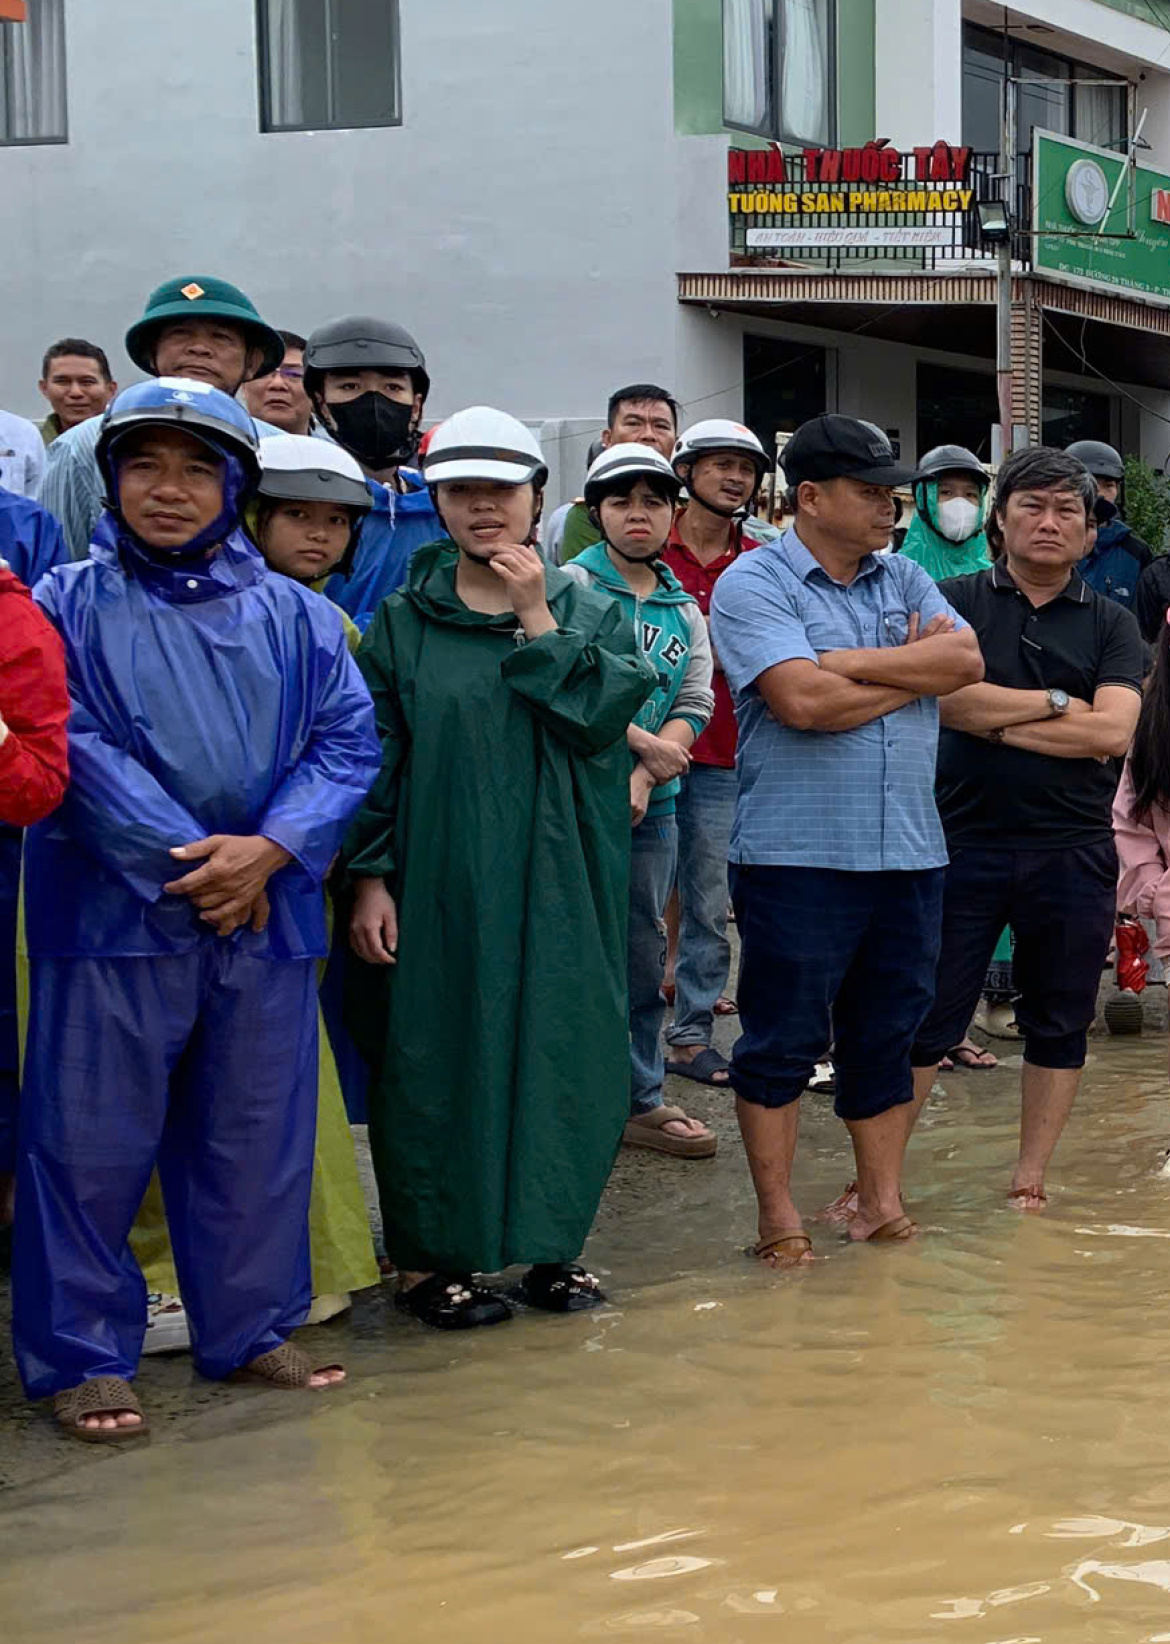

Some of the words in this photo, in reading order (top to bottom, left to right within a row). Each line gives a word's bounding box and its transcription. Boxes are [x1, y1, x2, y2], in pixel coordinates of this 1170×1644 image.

[729, 142, 786, 183] NHÀ
[804, 138, 900, 183] THUỐC
[913, 139, 970, 182] TÂY
[801, 193, 844, 213] SAN
[849, 190, 974, 213] PHARMACY
